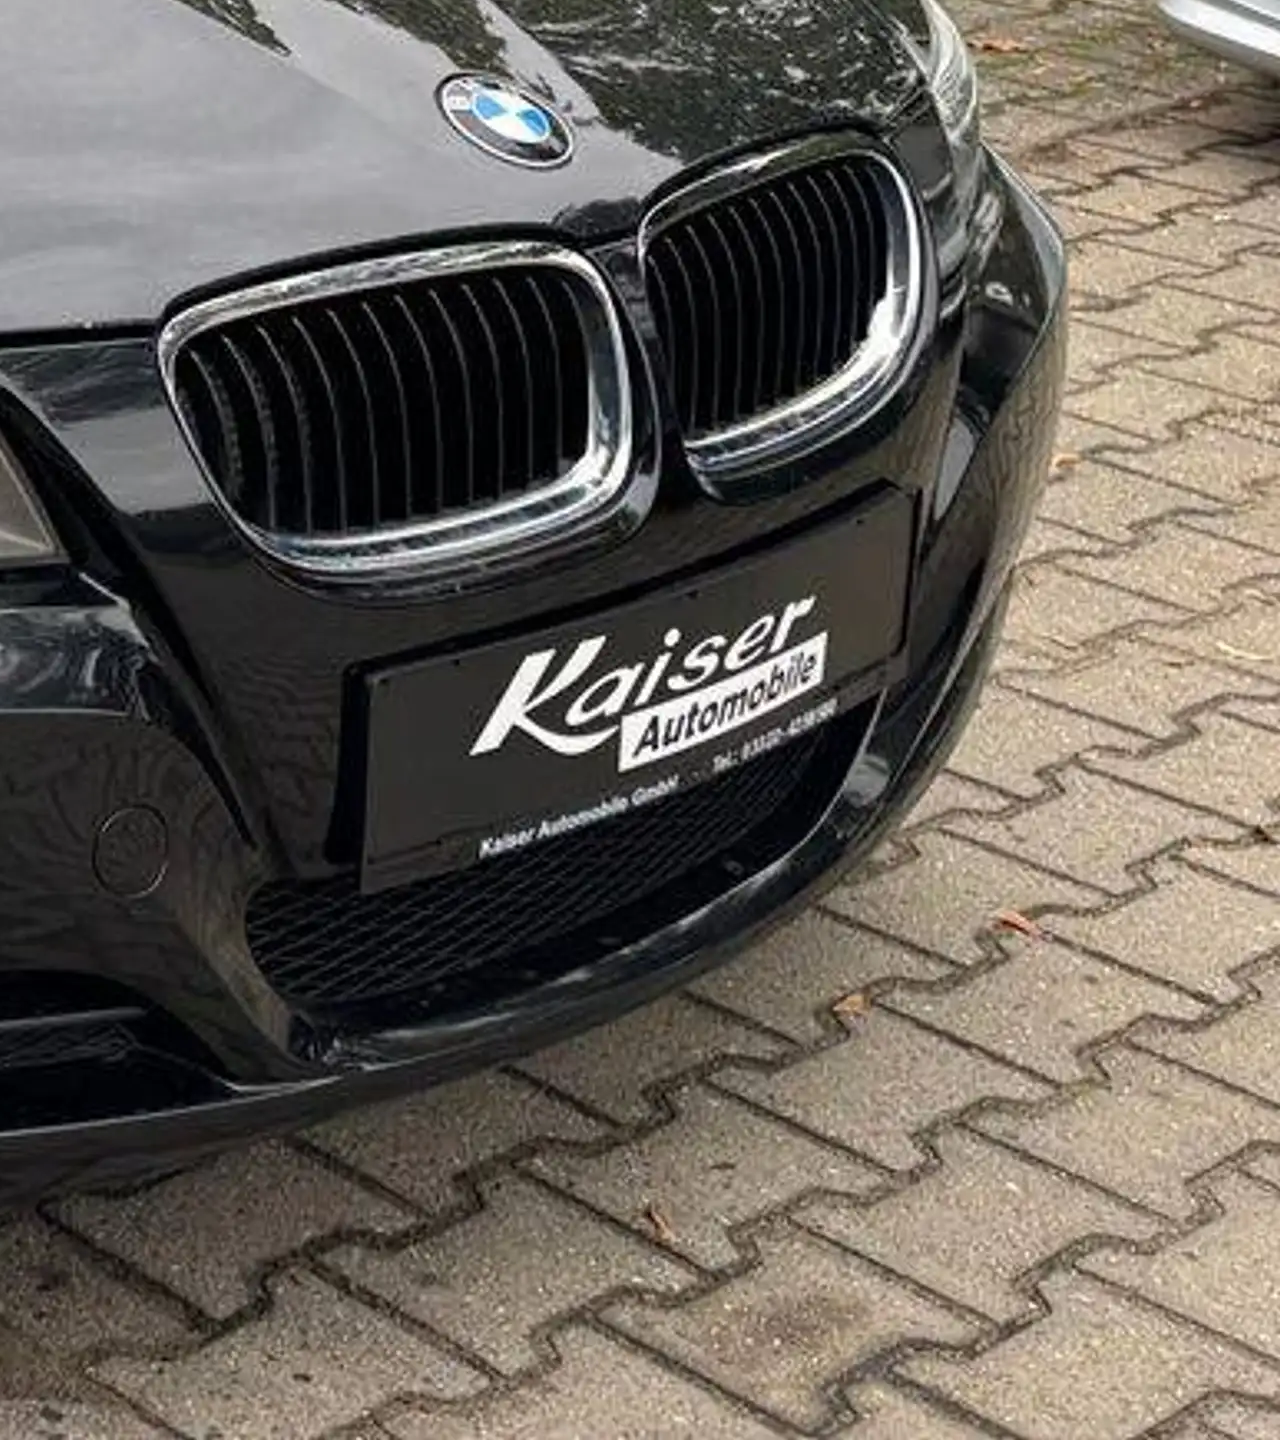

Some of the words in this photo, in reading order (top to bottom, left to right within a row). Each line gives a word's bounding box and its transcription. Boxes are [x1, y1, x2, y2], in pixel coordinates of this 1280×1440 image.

[469, 595, 816, 755] Kaiser
[633, 649, 817, 757] Automobile
[478, 827, 537, 859] Kaiser
[537, 796, 629, 839] Automobile
[630, 773, 679, 806] GmbH
